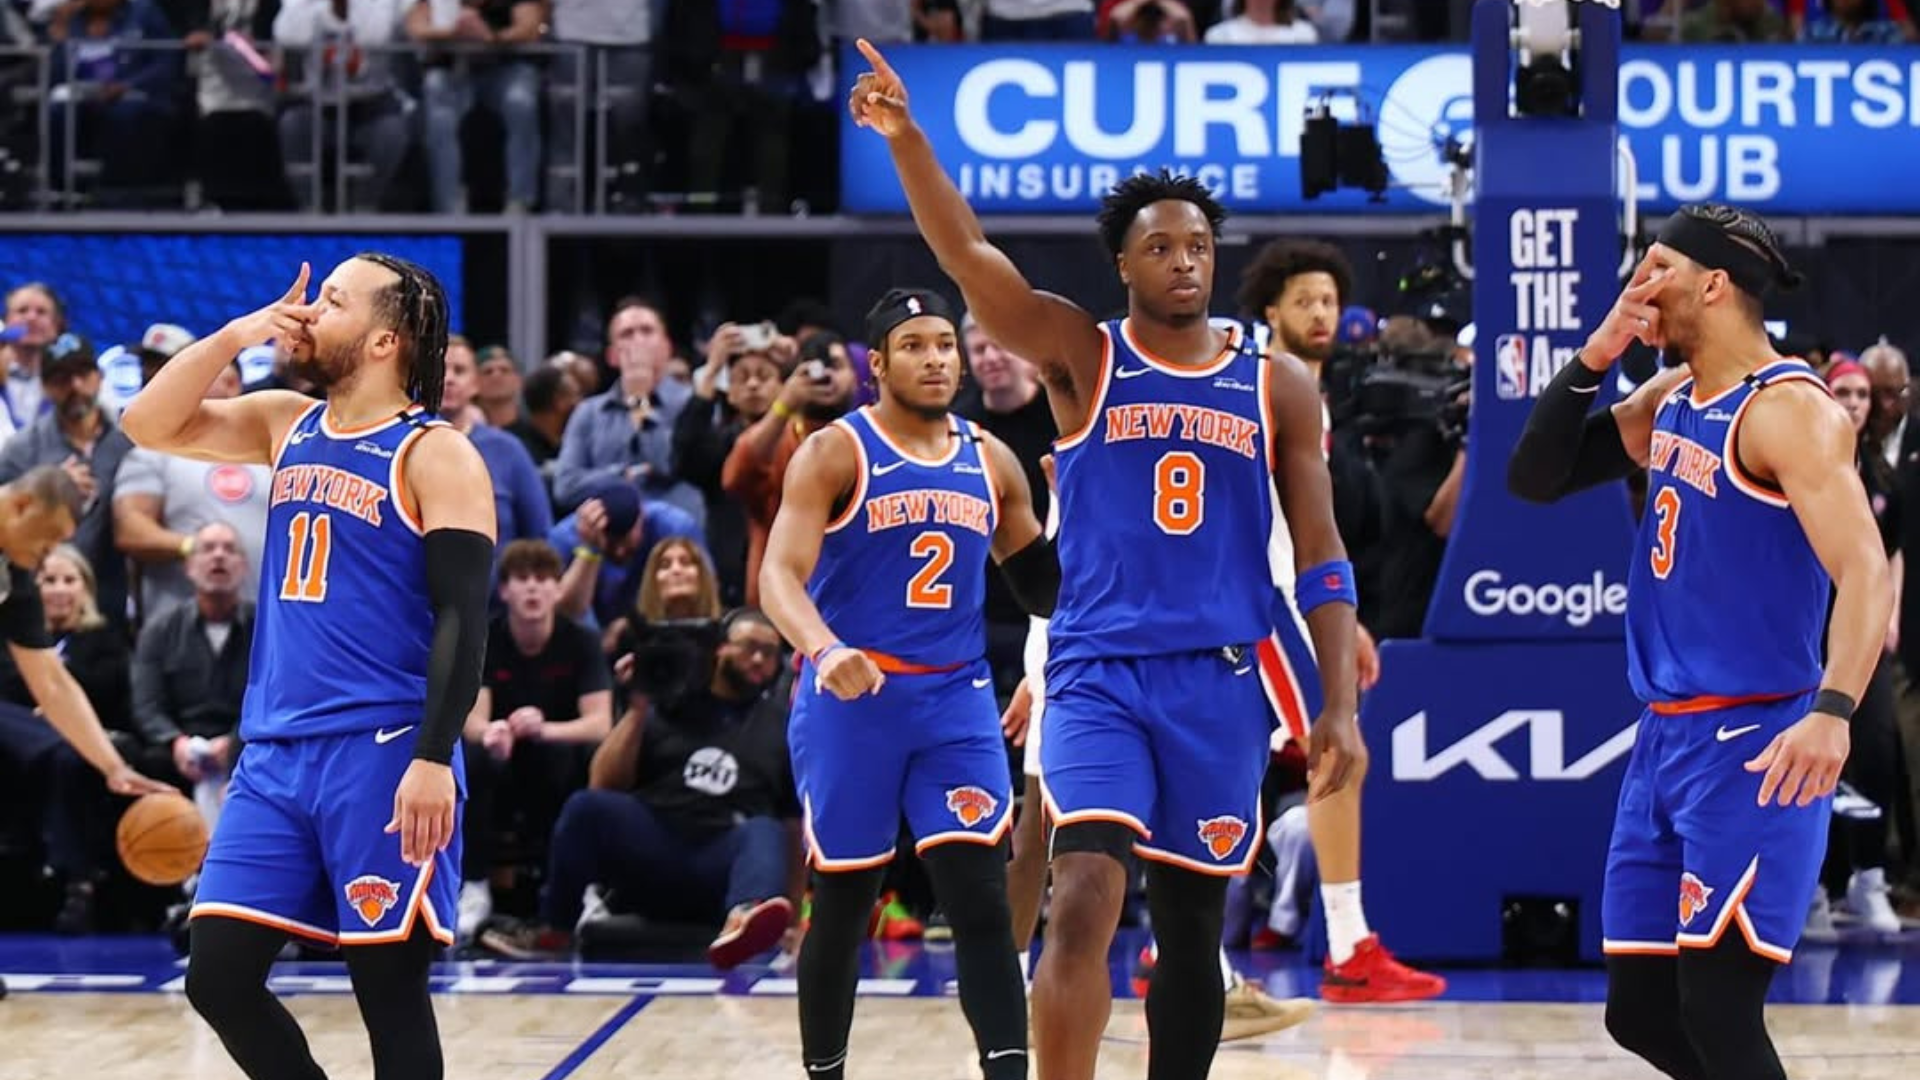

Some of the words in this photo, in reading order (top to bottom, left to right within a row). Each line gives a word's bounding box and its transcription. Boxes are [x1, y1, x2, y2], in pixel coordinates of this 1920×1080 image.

[960, 163, 1259, 200] INSURCE
[1510, 208, 1579, 269] GET
[1510, 271, 1581, 330] THE
[1153, 451, 1205, 535] 8
[279, 511, 331, 603] 11
[1651, 486, 1681, 580] 3
[906, 531, 954, 609] 2
[1464, 570, 1628, 627] Google
